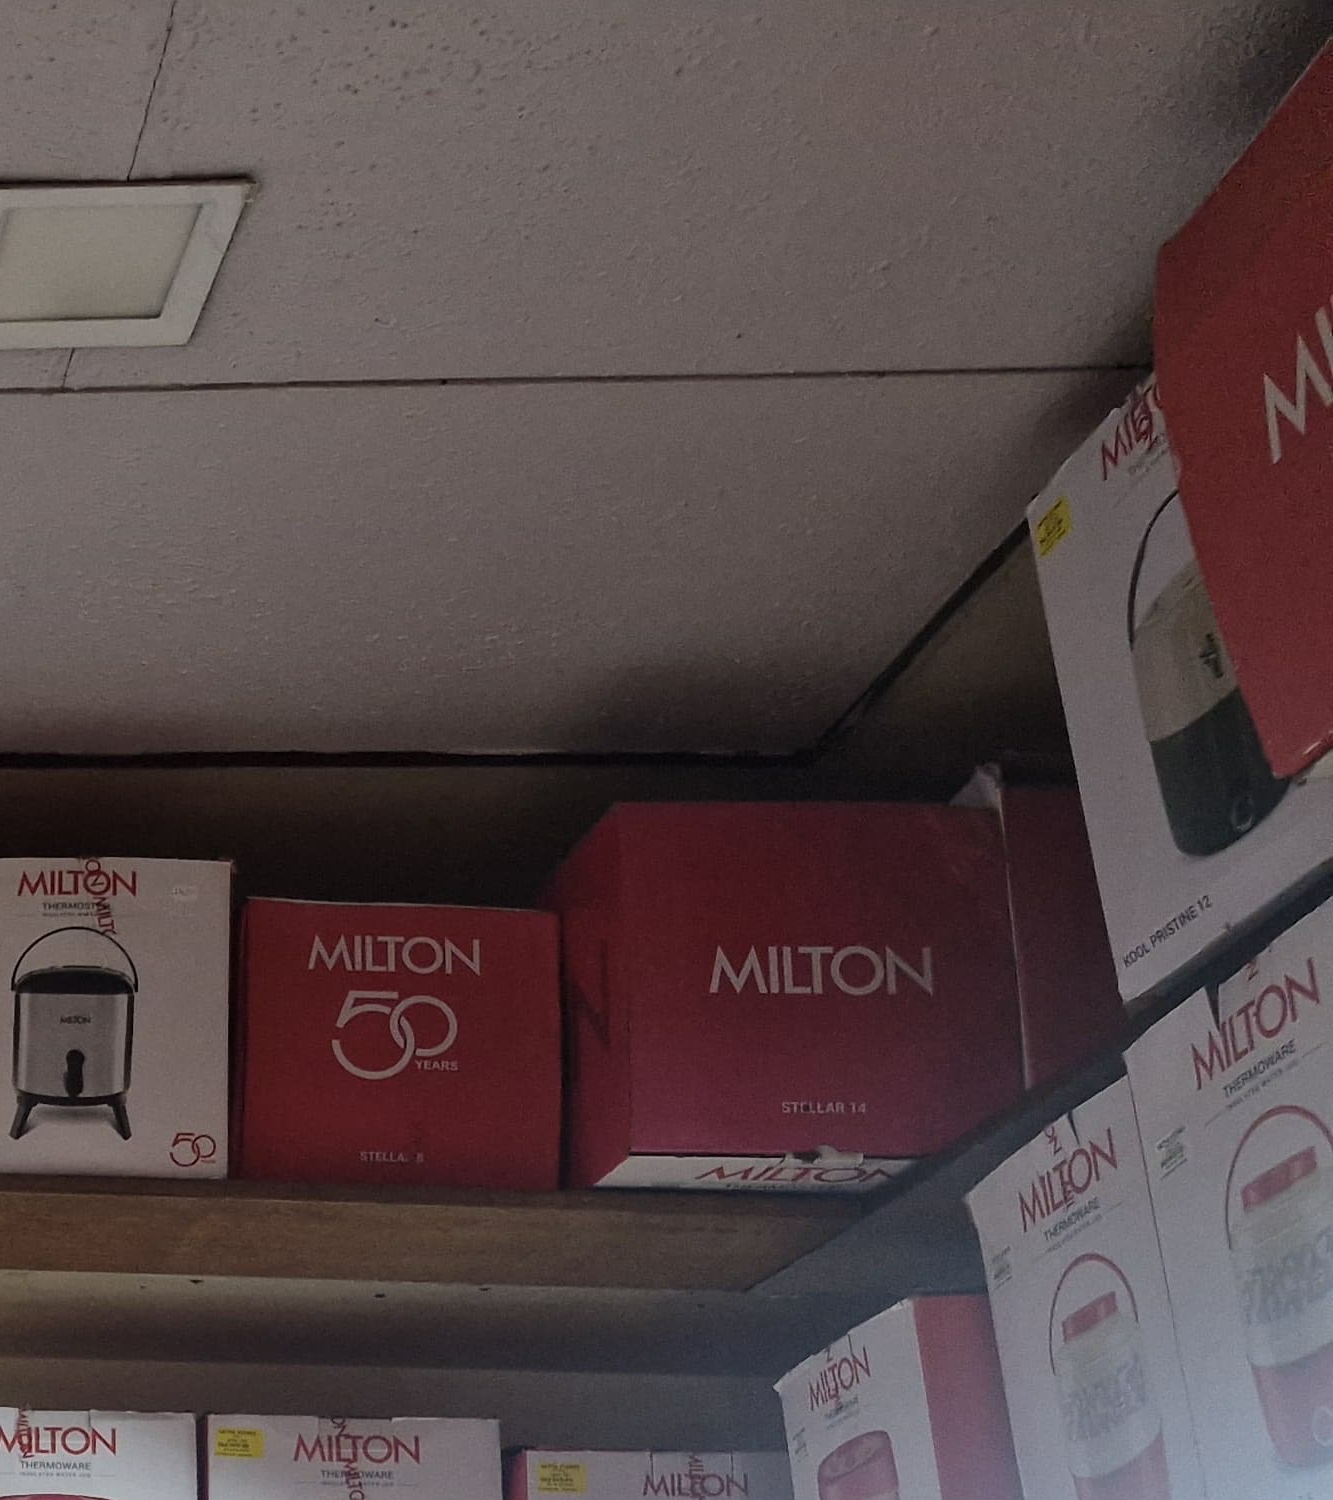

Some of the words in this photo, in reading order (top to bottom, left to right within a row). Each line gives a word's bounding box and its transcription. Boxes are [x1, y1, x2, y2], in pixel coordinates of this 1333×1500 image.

[17, 870, 137, 896] MILTON
[1122, 940, 1151, 969] KOOL
[1150, 907, 1196, 948] PRISTINE
[1198, 895, 1213, 912] 12
[308, 935, 481, 976] MILTON
[709, 946, 933, 995] MILTON
[331, 991, 458, 1080] 50
[1190, 957, 1321, 1091] MILTON
[415, 1060, 458, 1071] YEARS
[695, 1166, 894, 1183] MILTON
[1018, 1128, 1118, 1233] MILTON
[807, 1346, 871, 1411] MILTON
[293, 1434, 421, 1465] MILTON
[643, 1473, 749, 1497] MILTON
